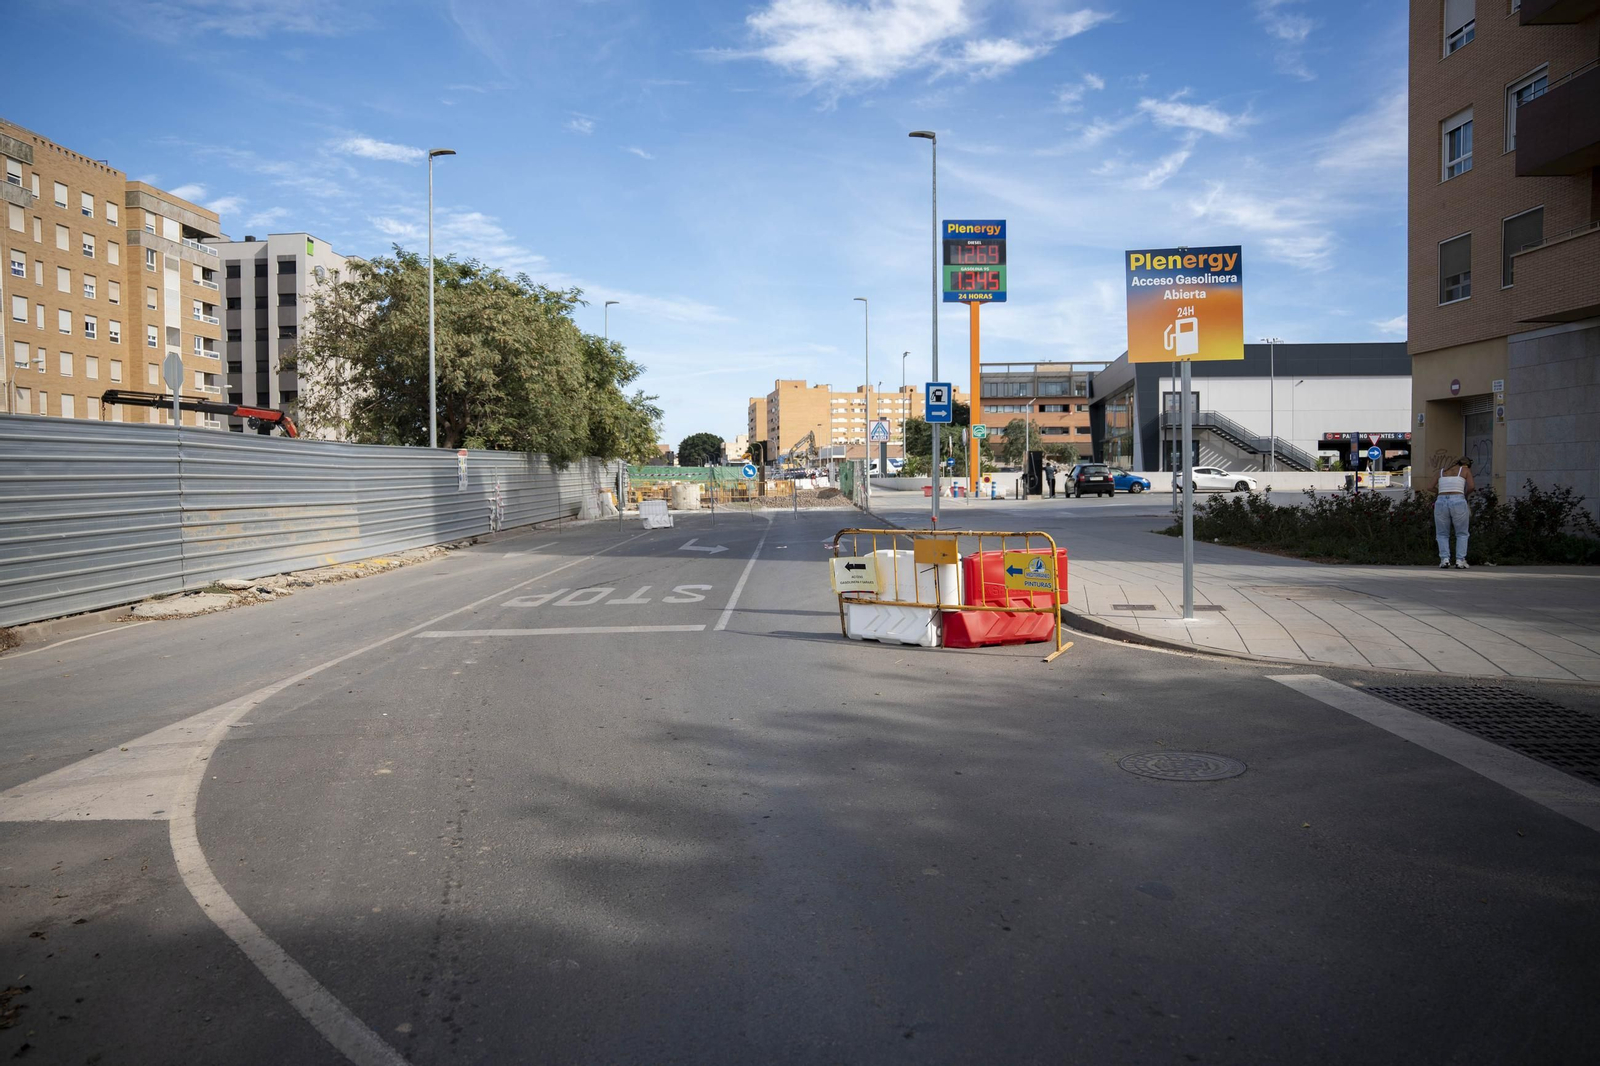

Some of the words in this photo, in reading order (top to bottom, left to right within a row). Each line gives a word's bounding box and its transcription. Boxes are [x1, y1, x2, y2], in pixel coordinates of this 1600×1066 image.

[948, 224, 1001, 235] Plenergy
[1130, 253, 1238, 272] Plenergy
[958, 271, 999, 290] 1.345
[1131, 276, 1174, 287] Acceso
[1175, 273, 1238, 285] Gasolinera
[1163, 289, 1207, 300] Abierta
[1176, 306, 1195, 318] 24H
[500, 584, 713, 607] STOP
